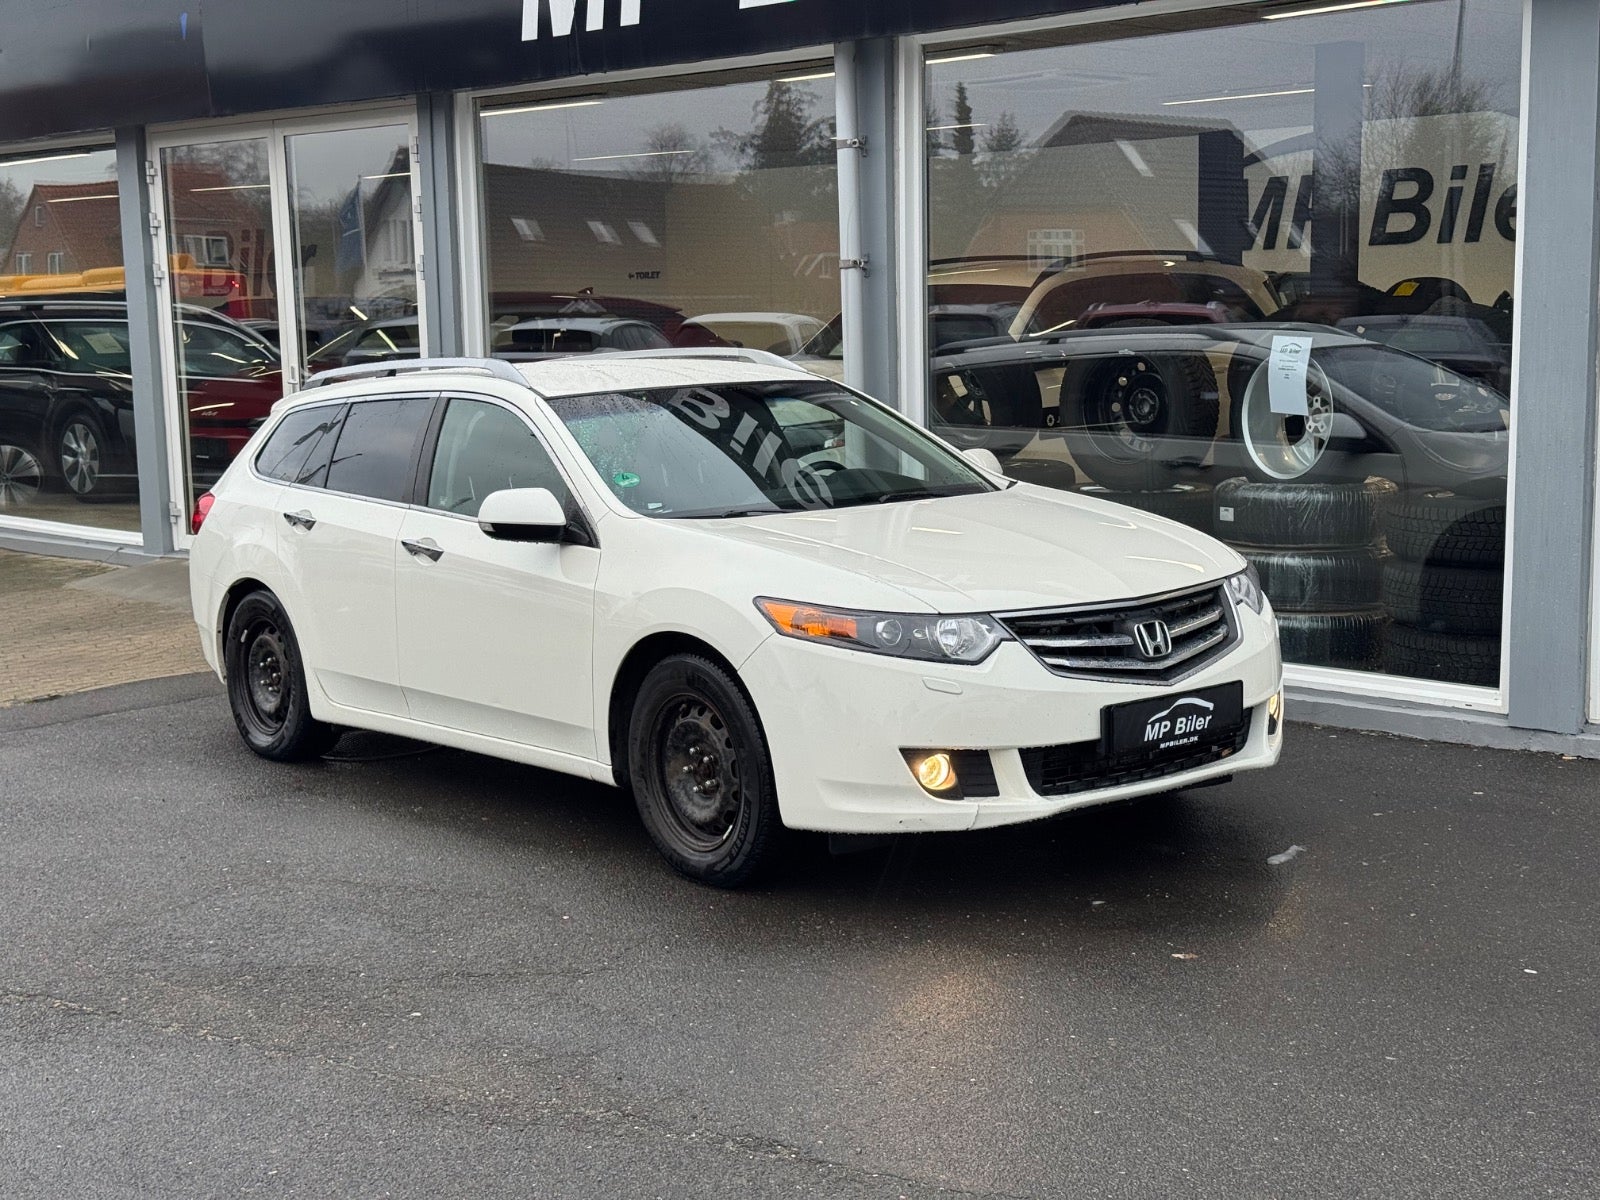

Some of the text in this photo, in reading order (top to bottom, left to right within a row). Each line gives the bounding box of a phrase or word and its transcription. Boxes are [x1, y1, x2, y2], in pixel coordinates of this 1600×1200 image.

[634, 271, 661, 280] TOILET
[1143, 714, 1212, 742] MP Biler
[1159, 735, 1199, 749] MPBILER.DK
